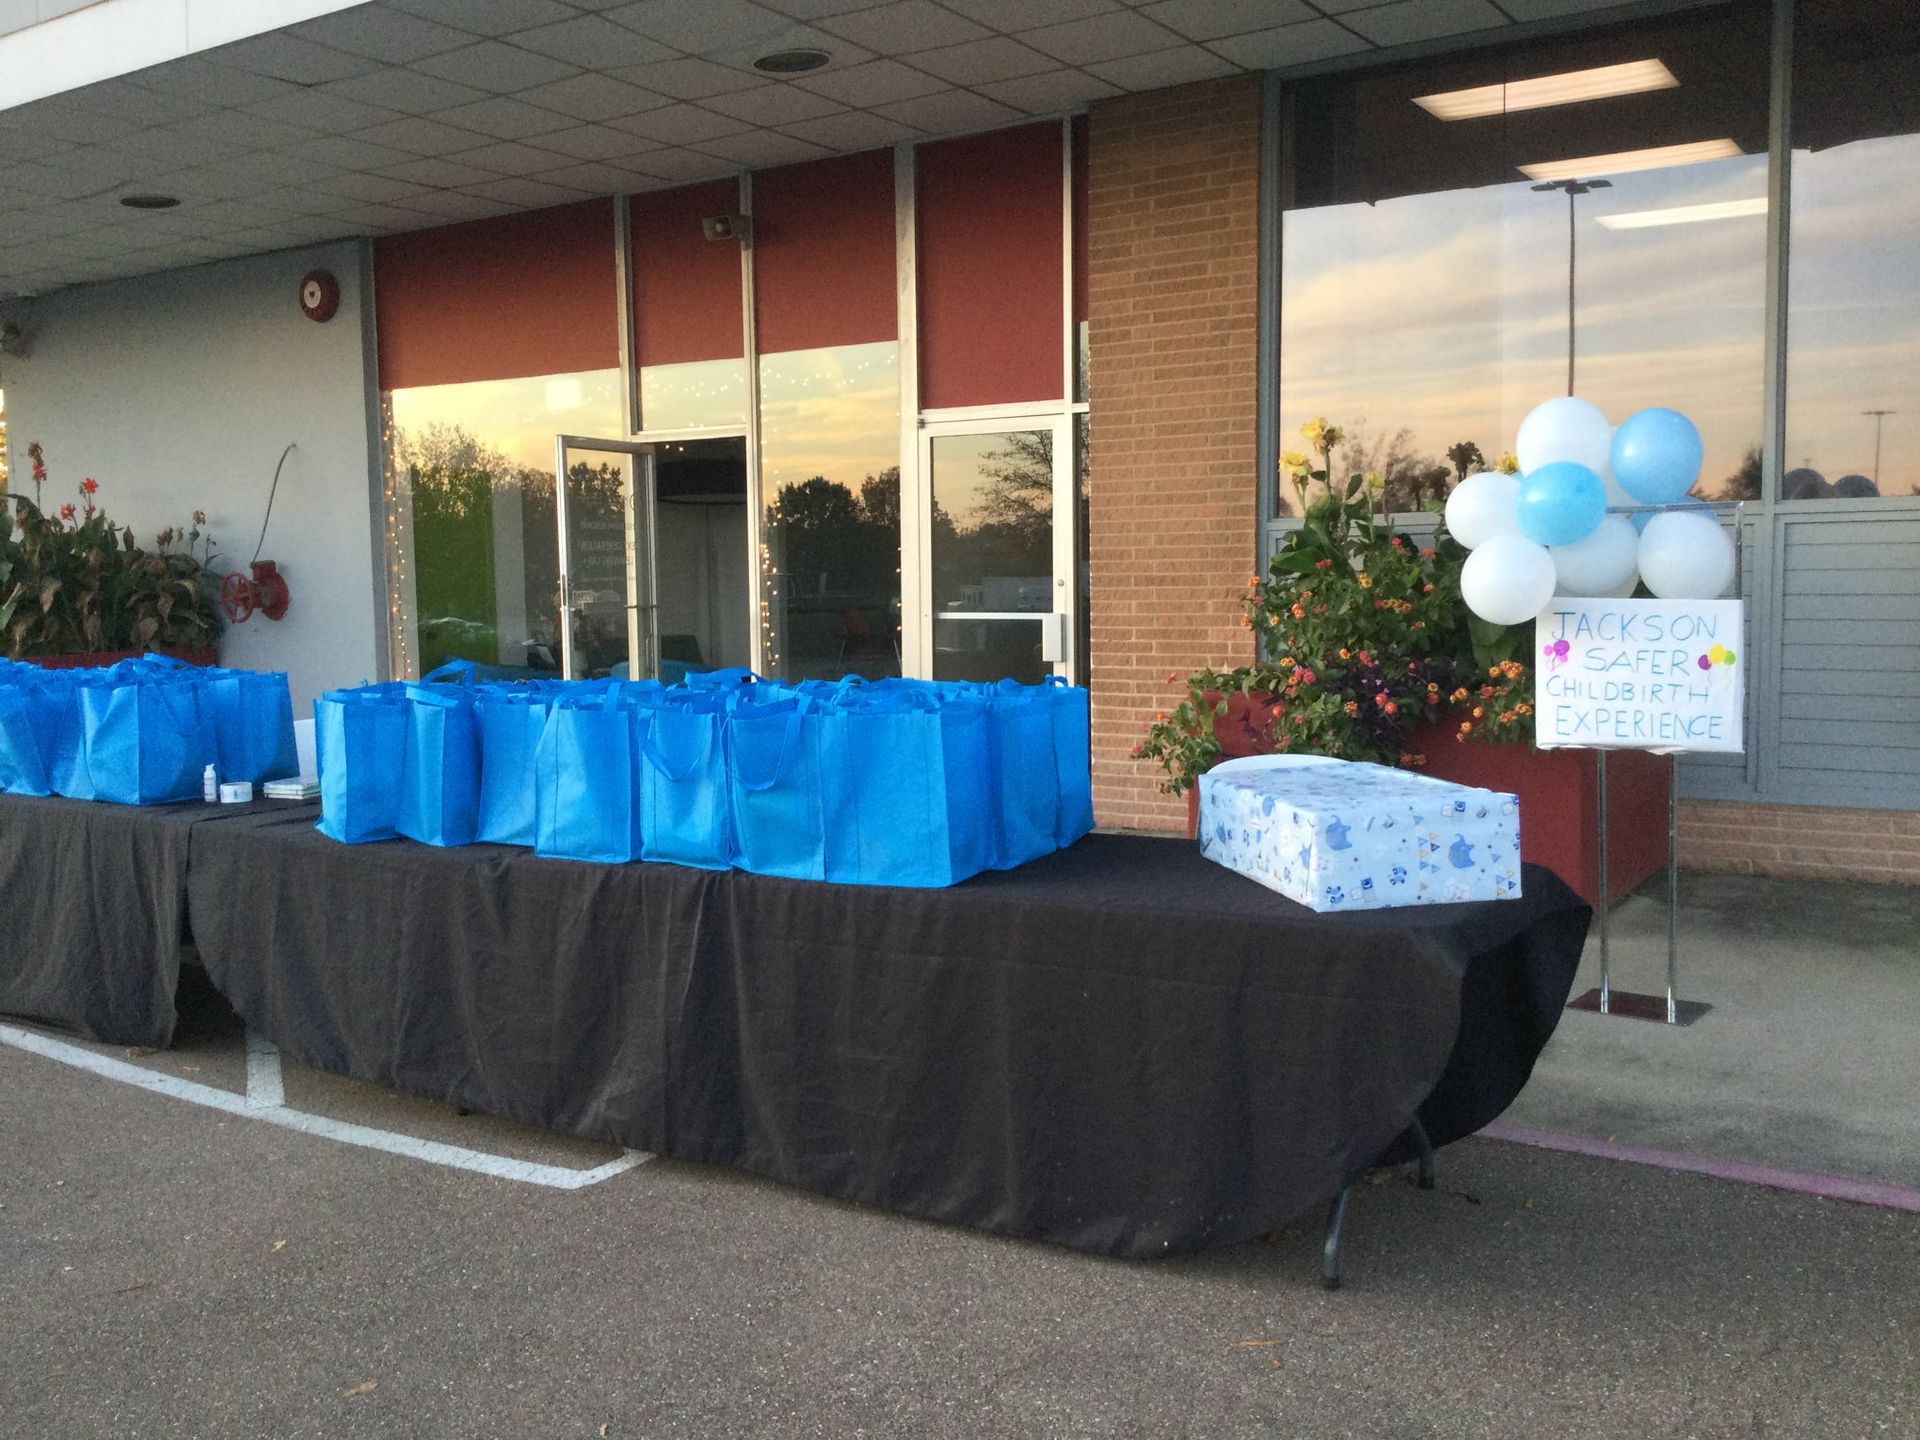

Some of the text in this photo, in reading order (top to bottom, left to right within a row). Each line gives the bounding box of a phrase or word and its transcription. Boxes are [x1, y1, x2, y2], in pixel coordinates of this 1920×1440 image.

[1552, 612, 1717, 642] JACKSON
[1583, 648, 1690, 676] SAFER
[1546, 675, 1710, 704] CHILDBIRTH
[1556, 706, 1723, 739] EXPERIENCE
